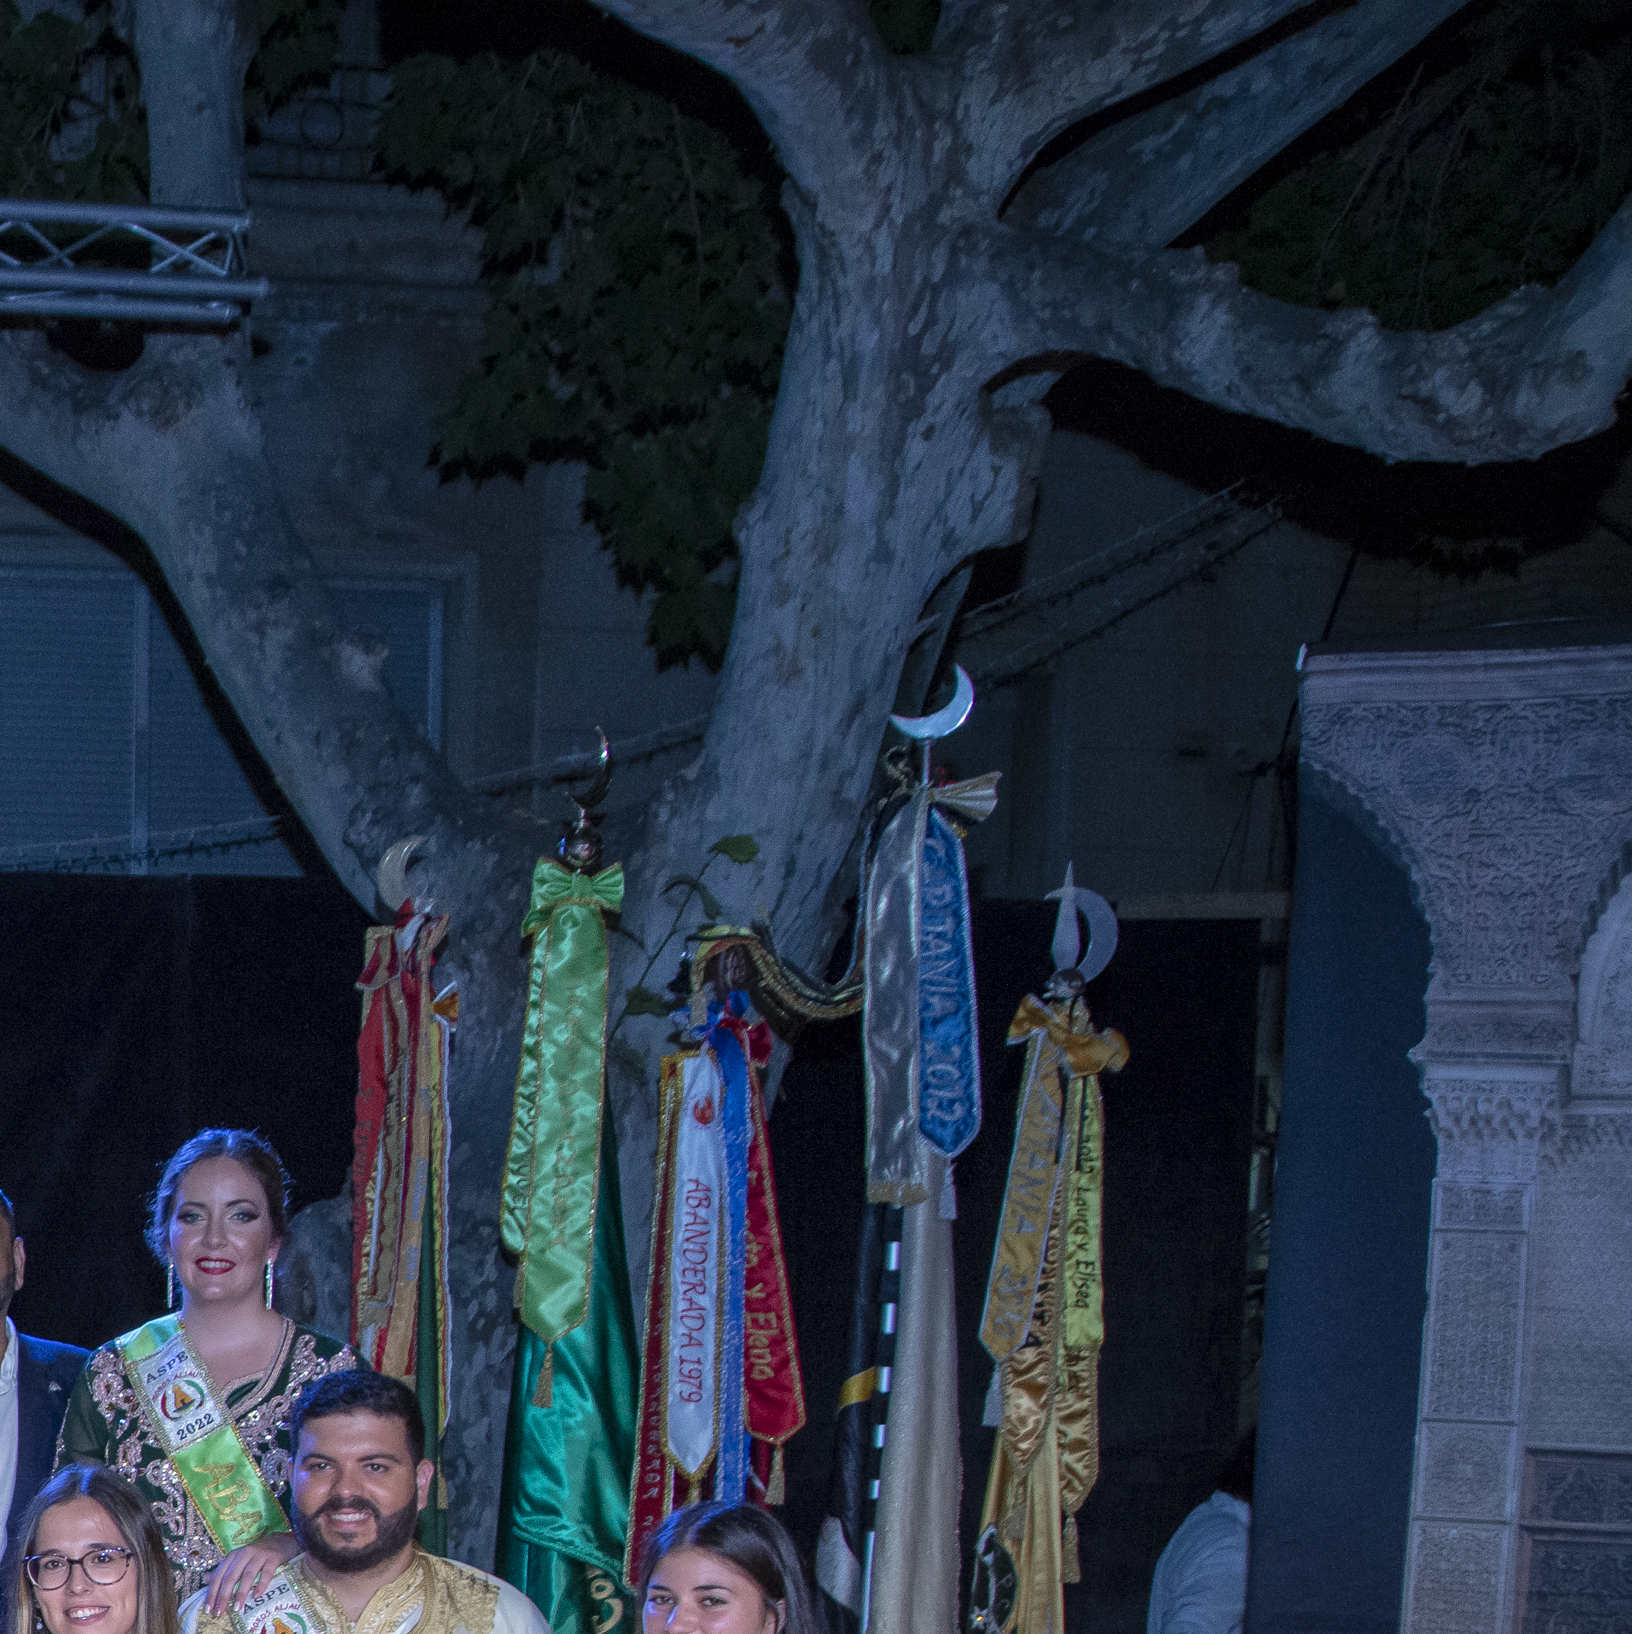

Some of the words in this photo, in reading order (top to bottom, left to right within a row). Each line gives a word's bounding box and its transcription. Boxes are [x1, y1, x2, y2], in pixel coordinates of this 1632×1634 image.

[677, 1177, 711, 1349] ABANDERADA
[745, 1311, 778, 1381] Elena
[146, 1350, 188, 1384] ASPE
[678, 1355, 703, 1404] 1979
[177, 1413, 215, 1440] 2022
[243, 1583, 290, 1615] ASPE
[248, 1610, 272, 1634] MOROS
[274, 1603, 301, 1613] ALJAU
